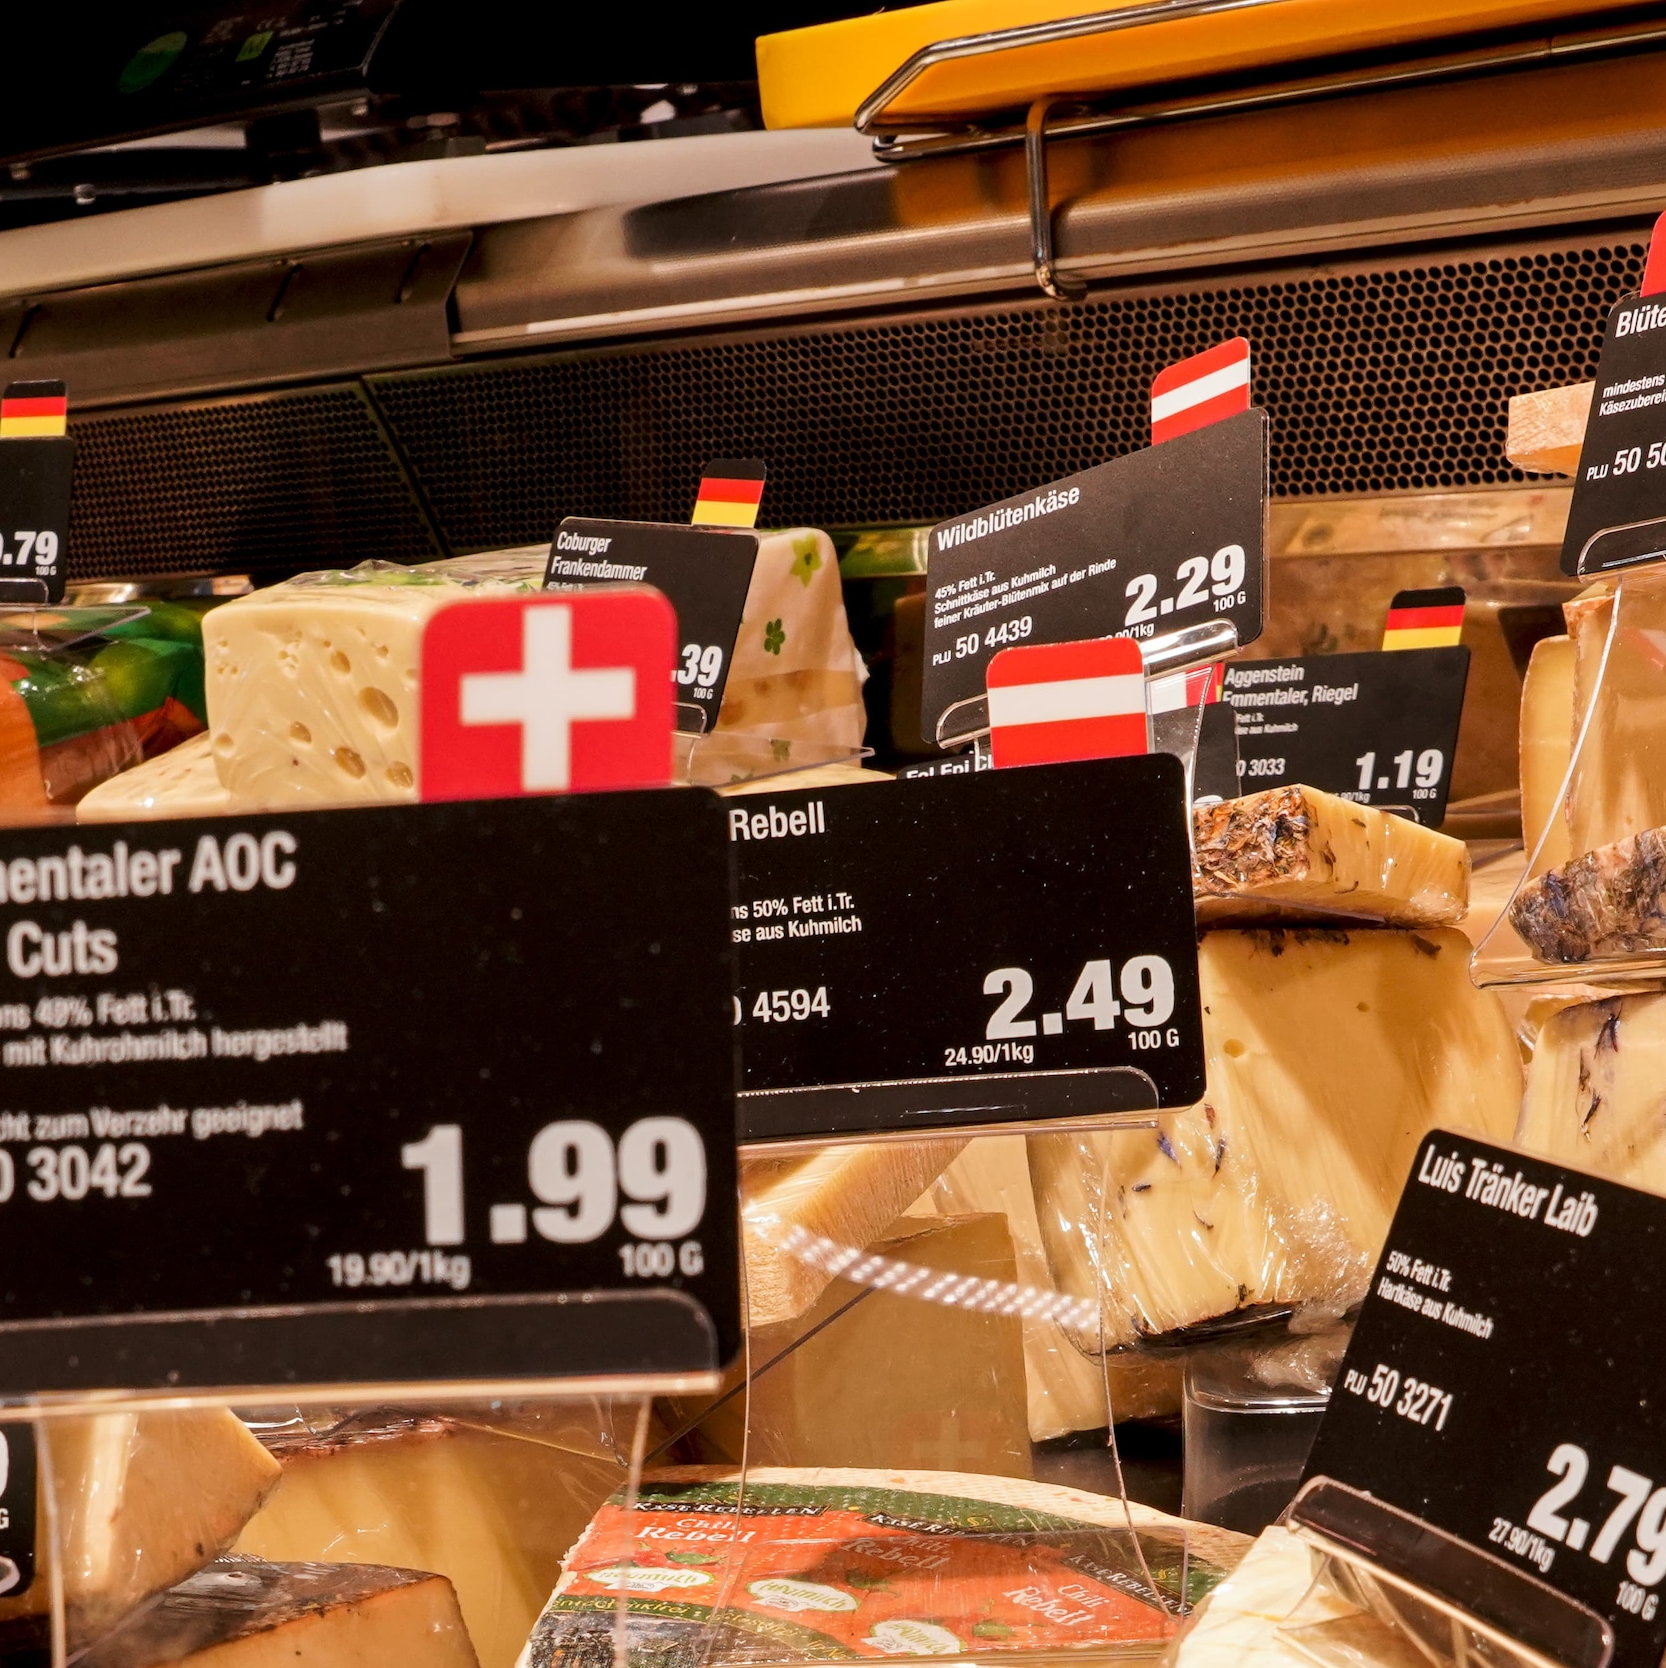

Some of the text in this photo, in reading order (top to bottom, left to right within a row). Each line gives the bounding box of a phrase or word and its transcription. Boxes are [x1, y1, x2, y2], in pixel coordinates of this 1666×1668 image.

[1601, 373, 1666, 399] mindestens
[1585, 462, 1609, 481] PLU
[1611, 445, 1642, 476] 50
[555, 530, 613, 556] Coburger
[936, 486, 1080, 551] Wildblütenkäse
[549, 554, 648, 581] Frankendammer
[932, 557, 1117, 629] feiner Kräuter-Blütenmix auf der Rinde
[933, 563, 1057, 615] Schnittkäse aus Kuhmilch
[1123, 543, 1246, 627] 2.29
[931, 614, 1033, 666] PLU 50 4439
[1223, 663, 1305, 689] Aggenstein
[1310, 681, 1359, 706] Riegel
[1351, 747, 1444, 794] 1.19
[728, 799, 825, 842] Rebell
[188, 830, 297, 893] AOC
[752, 891, 855, 918] 50% Fett i.Tr.
[6, 919, 118, 978] Cuts
[981, 953, 1175, 1041] 2.49
[943, 1041, 1034, 1067] 24.90/1kg
[26, 1142, 152, 1201] 3042
[400, 1115, 707, 1246] 1.99
[1416, 1143, 1599, 1237] Luis Tränker Laib
[1342, 1362, 1453, 1432] PLU 50 3271
